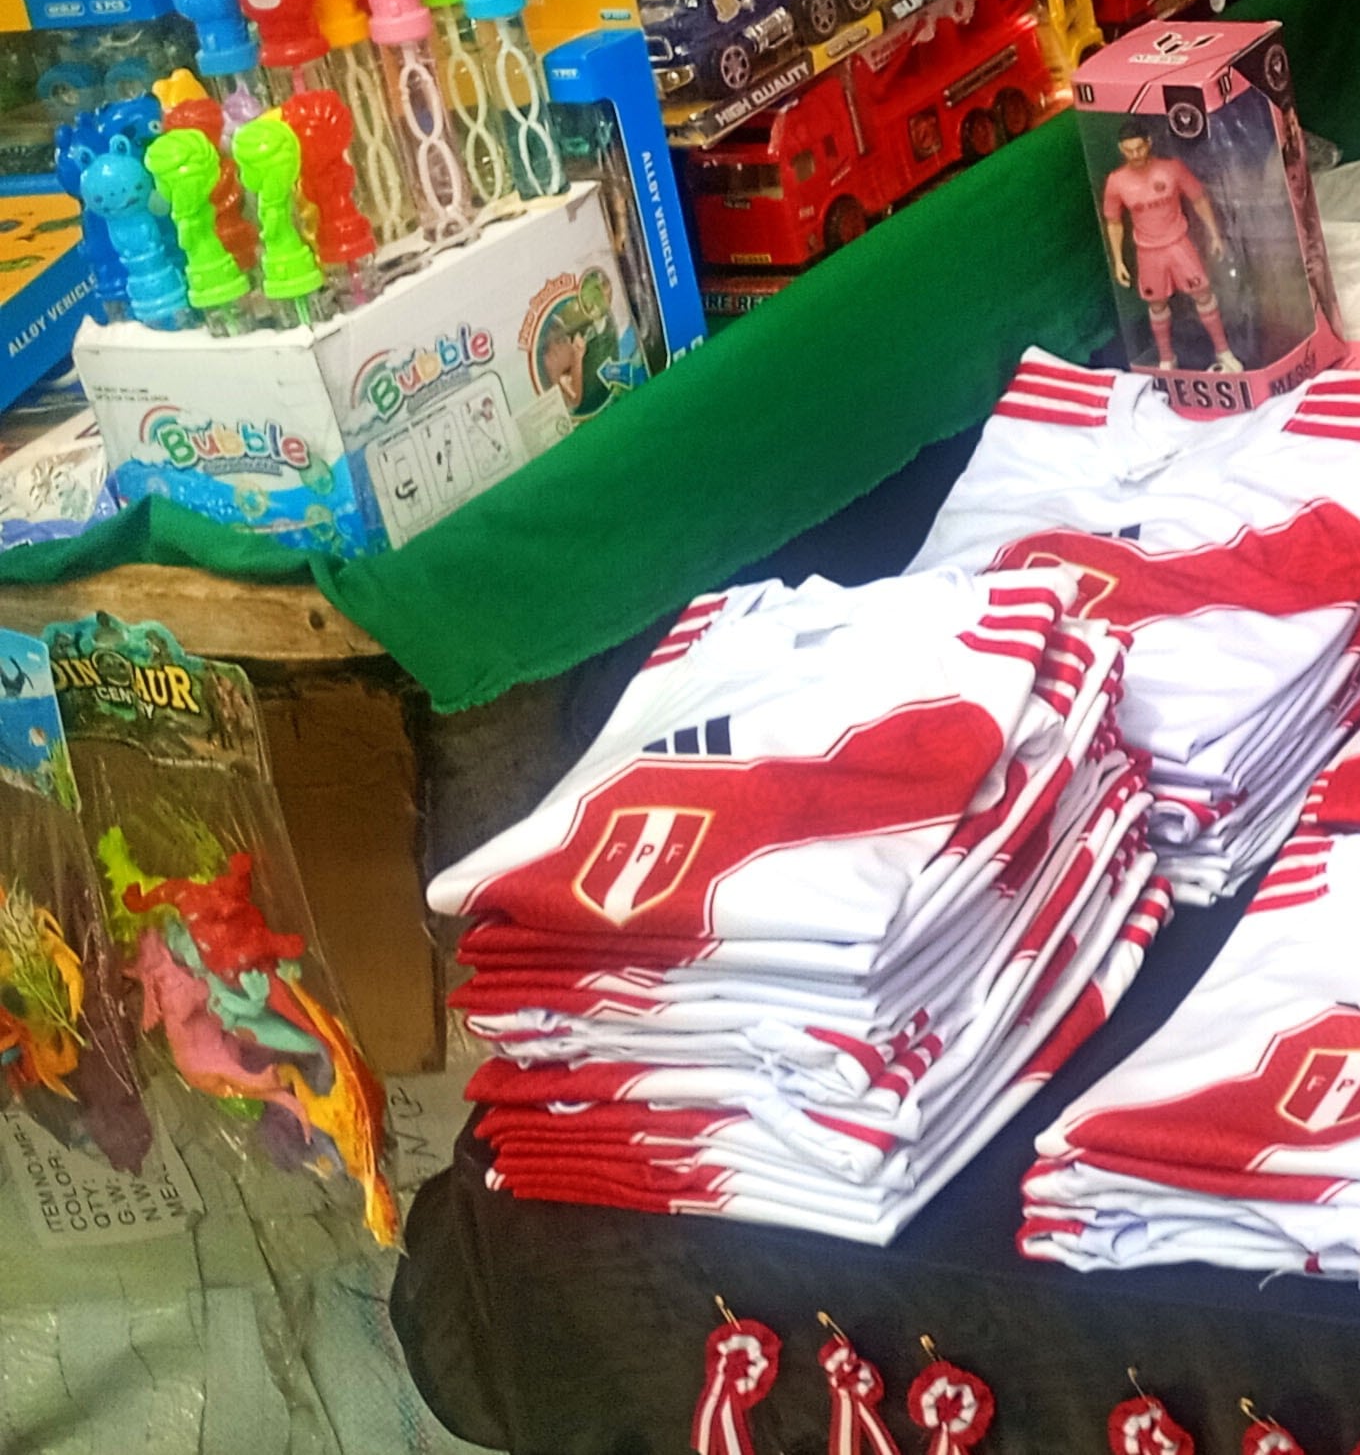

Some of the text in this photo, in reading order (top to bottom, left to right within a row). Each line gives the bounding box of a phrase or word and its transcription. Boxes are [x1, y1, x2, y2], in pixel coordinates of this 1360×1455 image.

[715, 64, 811, 127] HIGH QUALITY
[1077, 84, 1094, 103] 10
[641, 151, 679, 289] ALLOY VEHICLES
[8, 315, 47, 358] ALLOY
[368, 323, 493, 422] Bubble
[157, 419, 310, 469] Bubble
[606, 842, 684, 864] FPF
